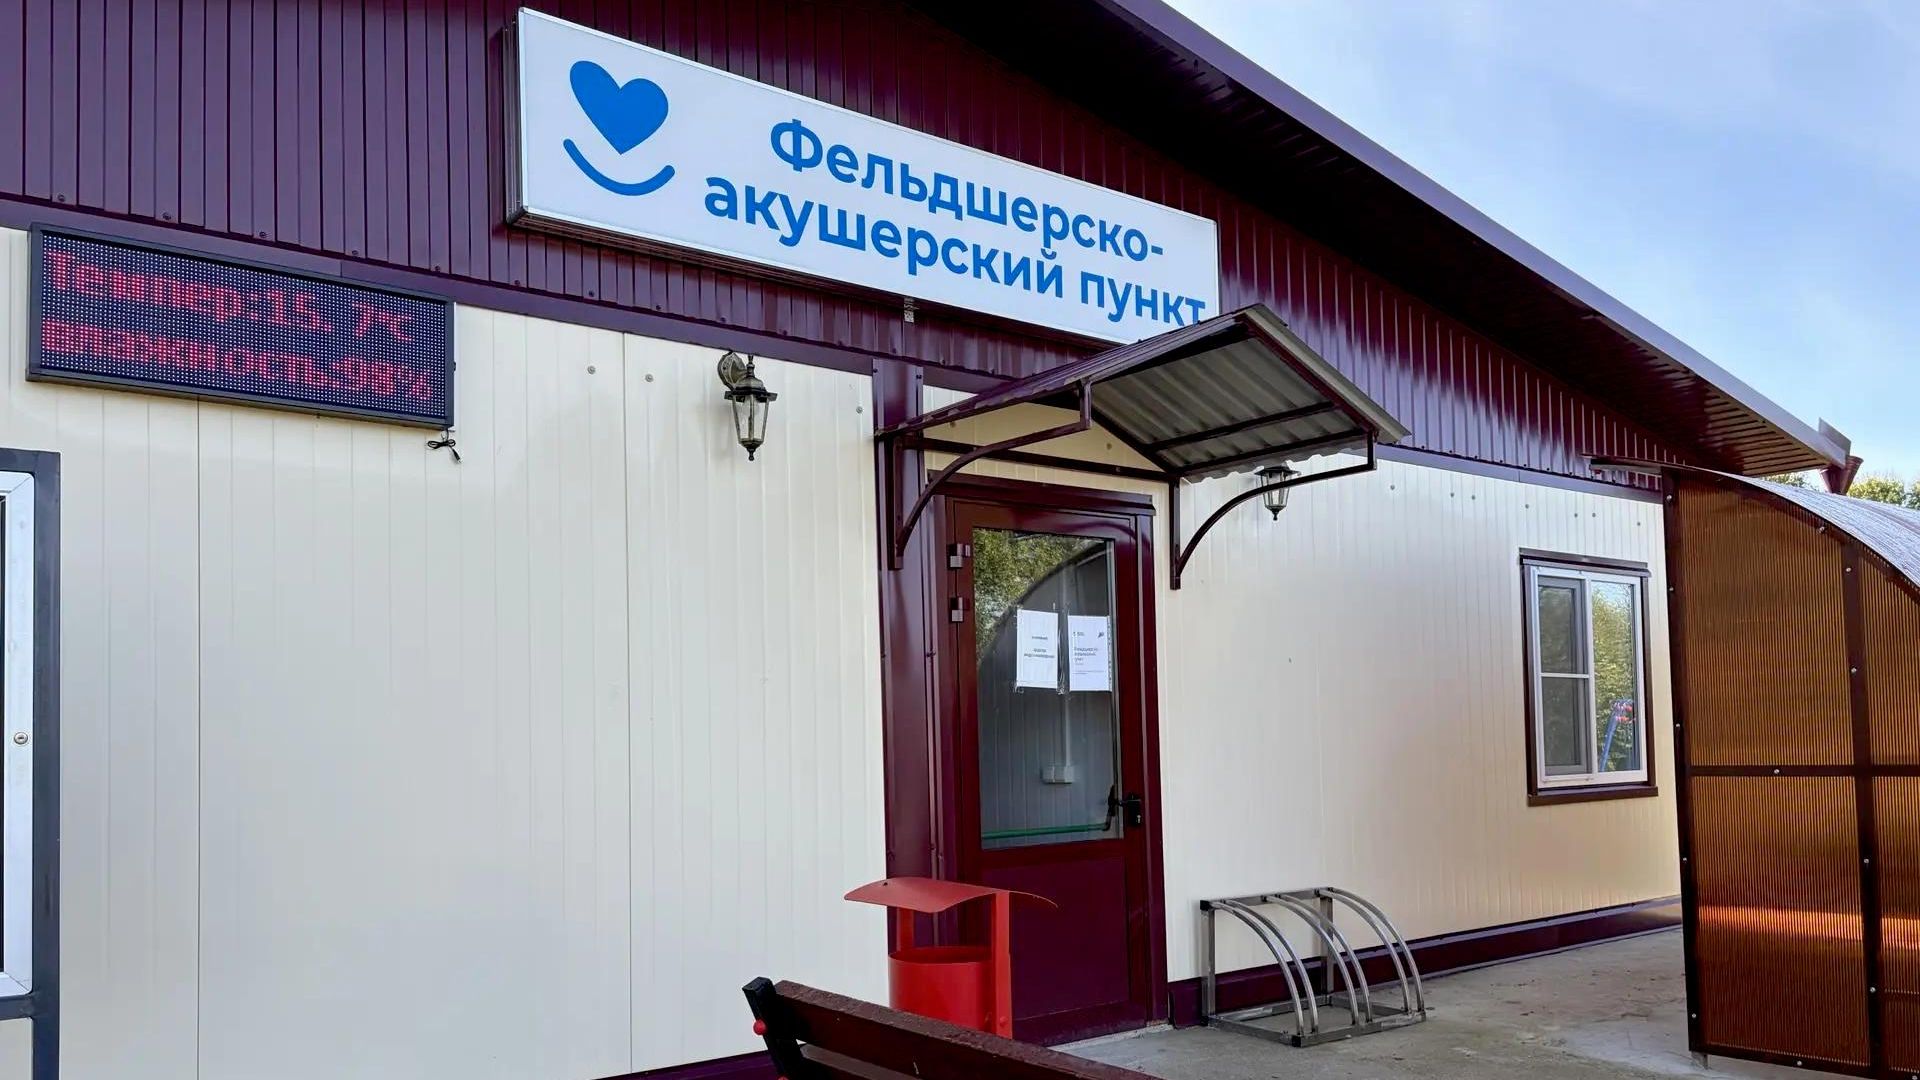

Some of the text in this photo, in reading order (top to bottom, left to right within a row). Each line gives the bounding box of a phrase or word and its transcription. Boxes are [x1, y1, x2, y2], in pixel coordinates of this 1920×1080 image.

[703, 176, 1207, 327] акушерский пункт
[770, 118, 1164, 262] Фельдшерско-
